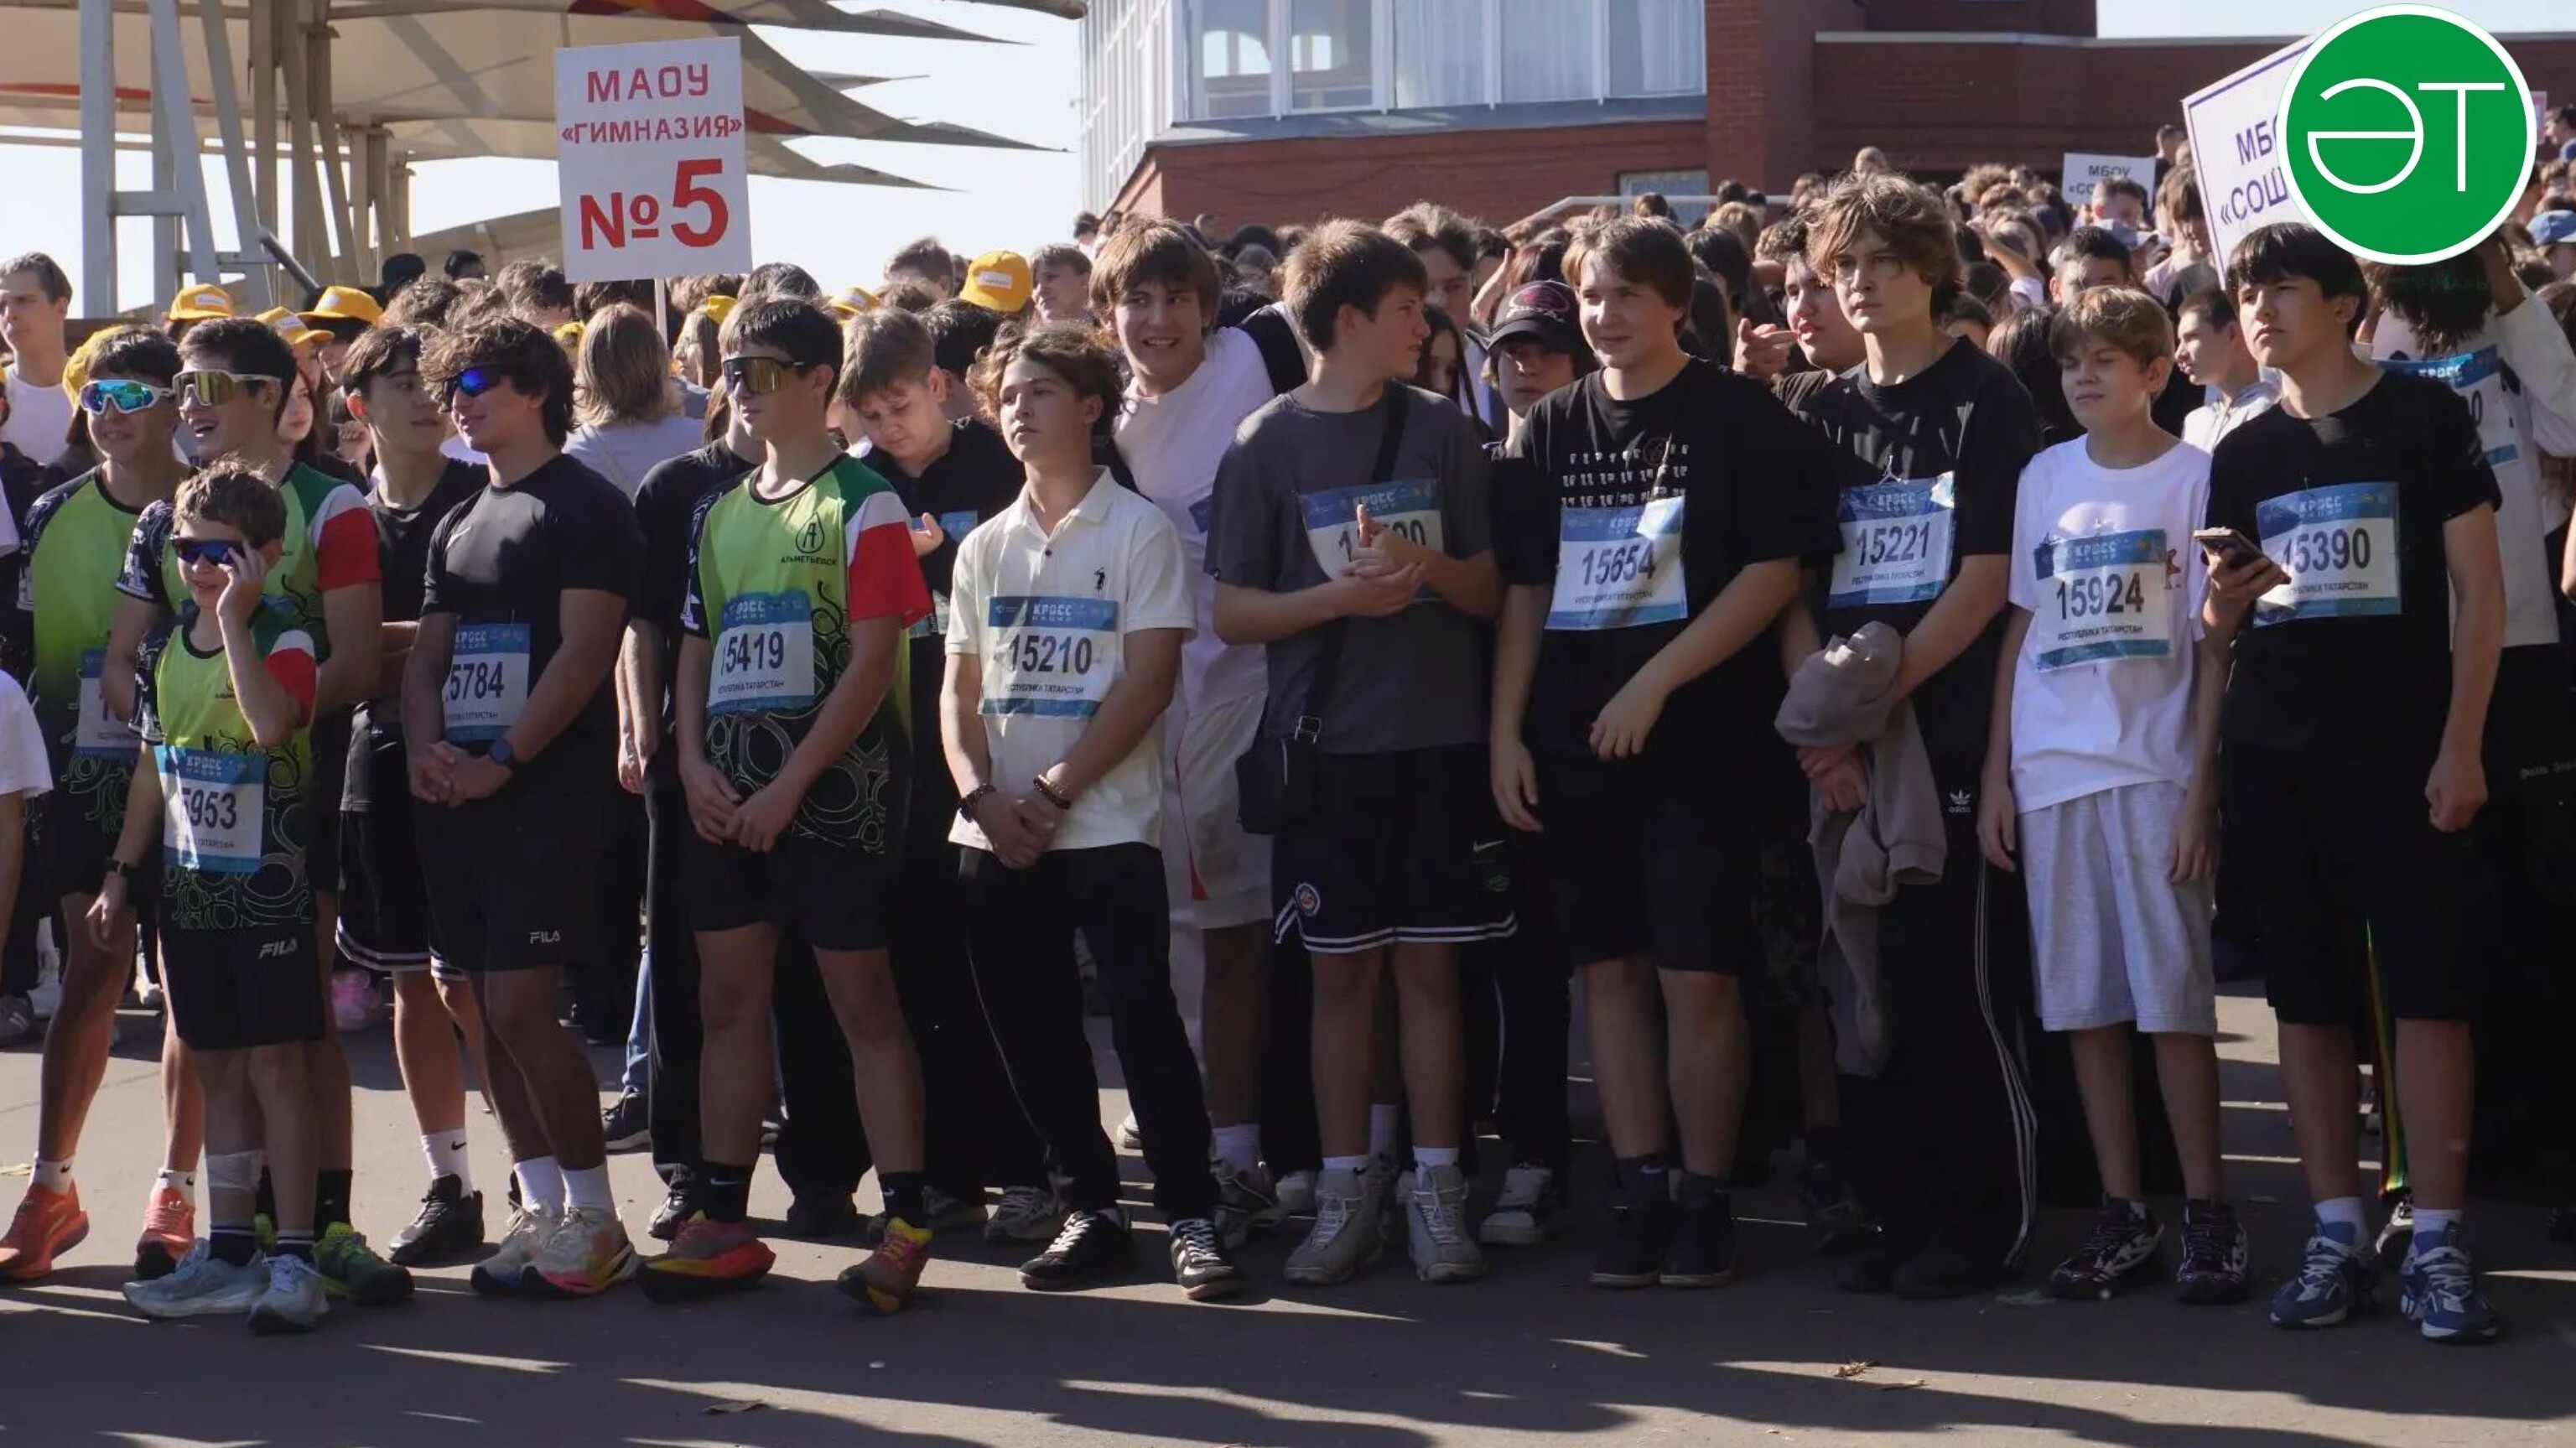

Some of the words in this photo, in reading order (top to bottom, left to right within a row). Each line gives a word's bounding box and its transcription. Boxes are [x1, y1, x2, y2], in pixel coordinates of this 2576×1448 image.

[587, 63, 709, 102] МАОУ
[562, 115, 742, 143] «ГИМНАЗИЯ»
[2236, 114, 2277, 165] МБ
[2069, 182, 2095, 195] «СО
[2089, 164, 2131, 177] МБОУ
[781, 555, 838, 566] АЛЬМЕТЬЕВСК
[1581, 541, 1657, 586] 15654
[1857, 522, 1930, 566] 15221
[2283, 527, 2371, 573] 15390
[1033, 604, 1072, 616] КРОСС
[2056, 573, 2144, 620] 15924
[1008, 634, 1093, 675] 15210
[447, 662, 505, 701] 5784
[258, 937, 298, 960] FILA
[529, 930, 561, 945] FILA
